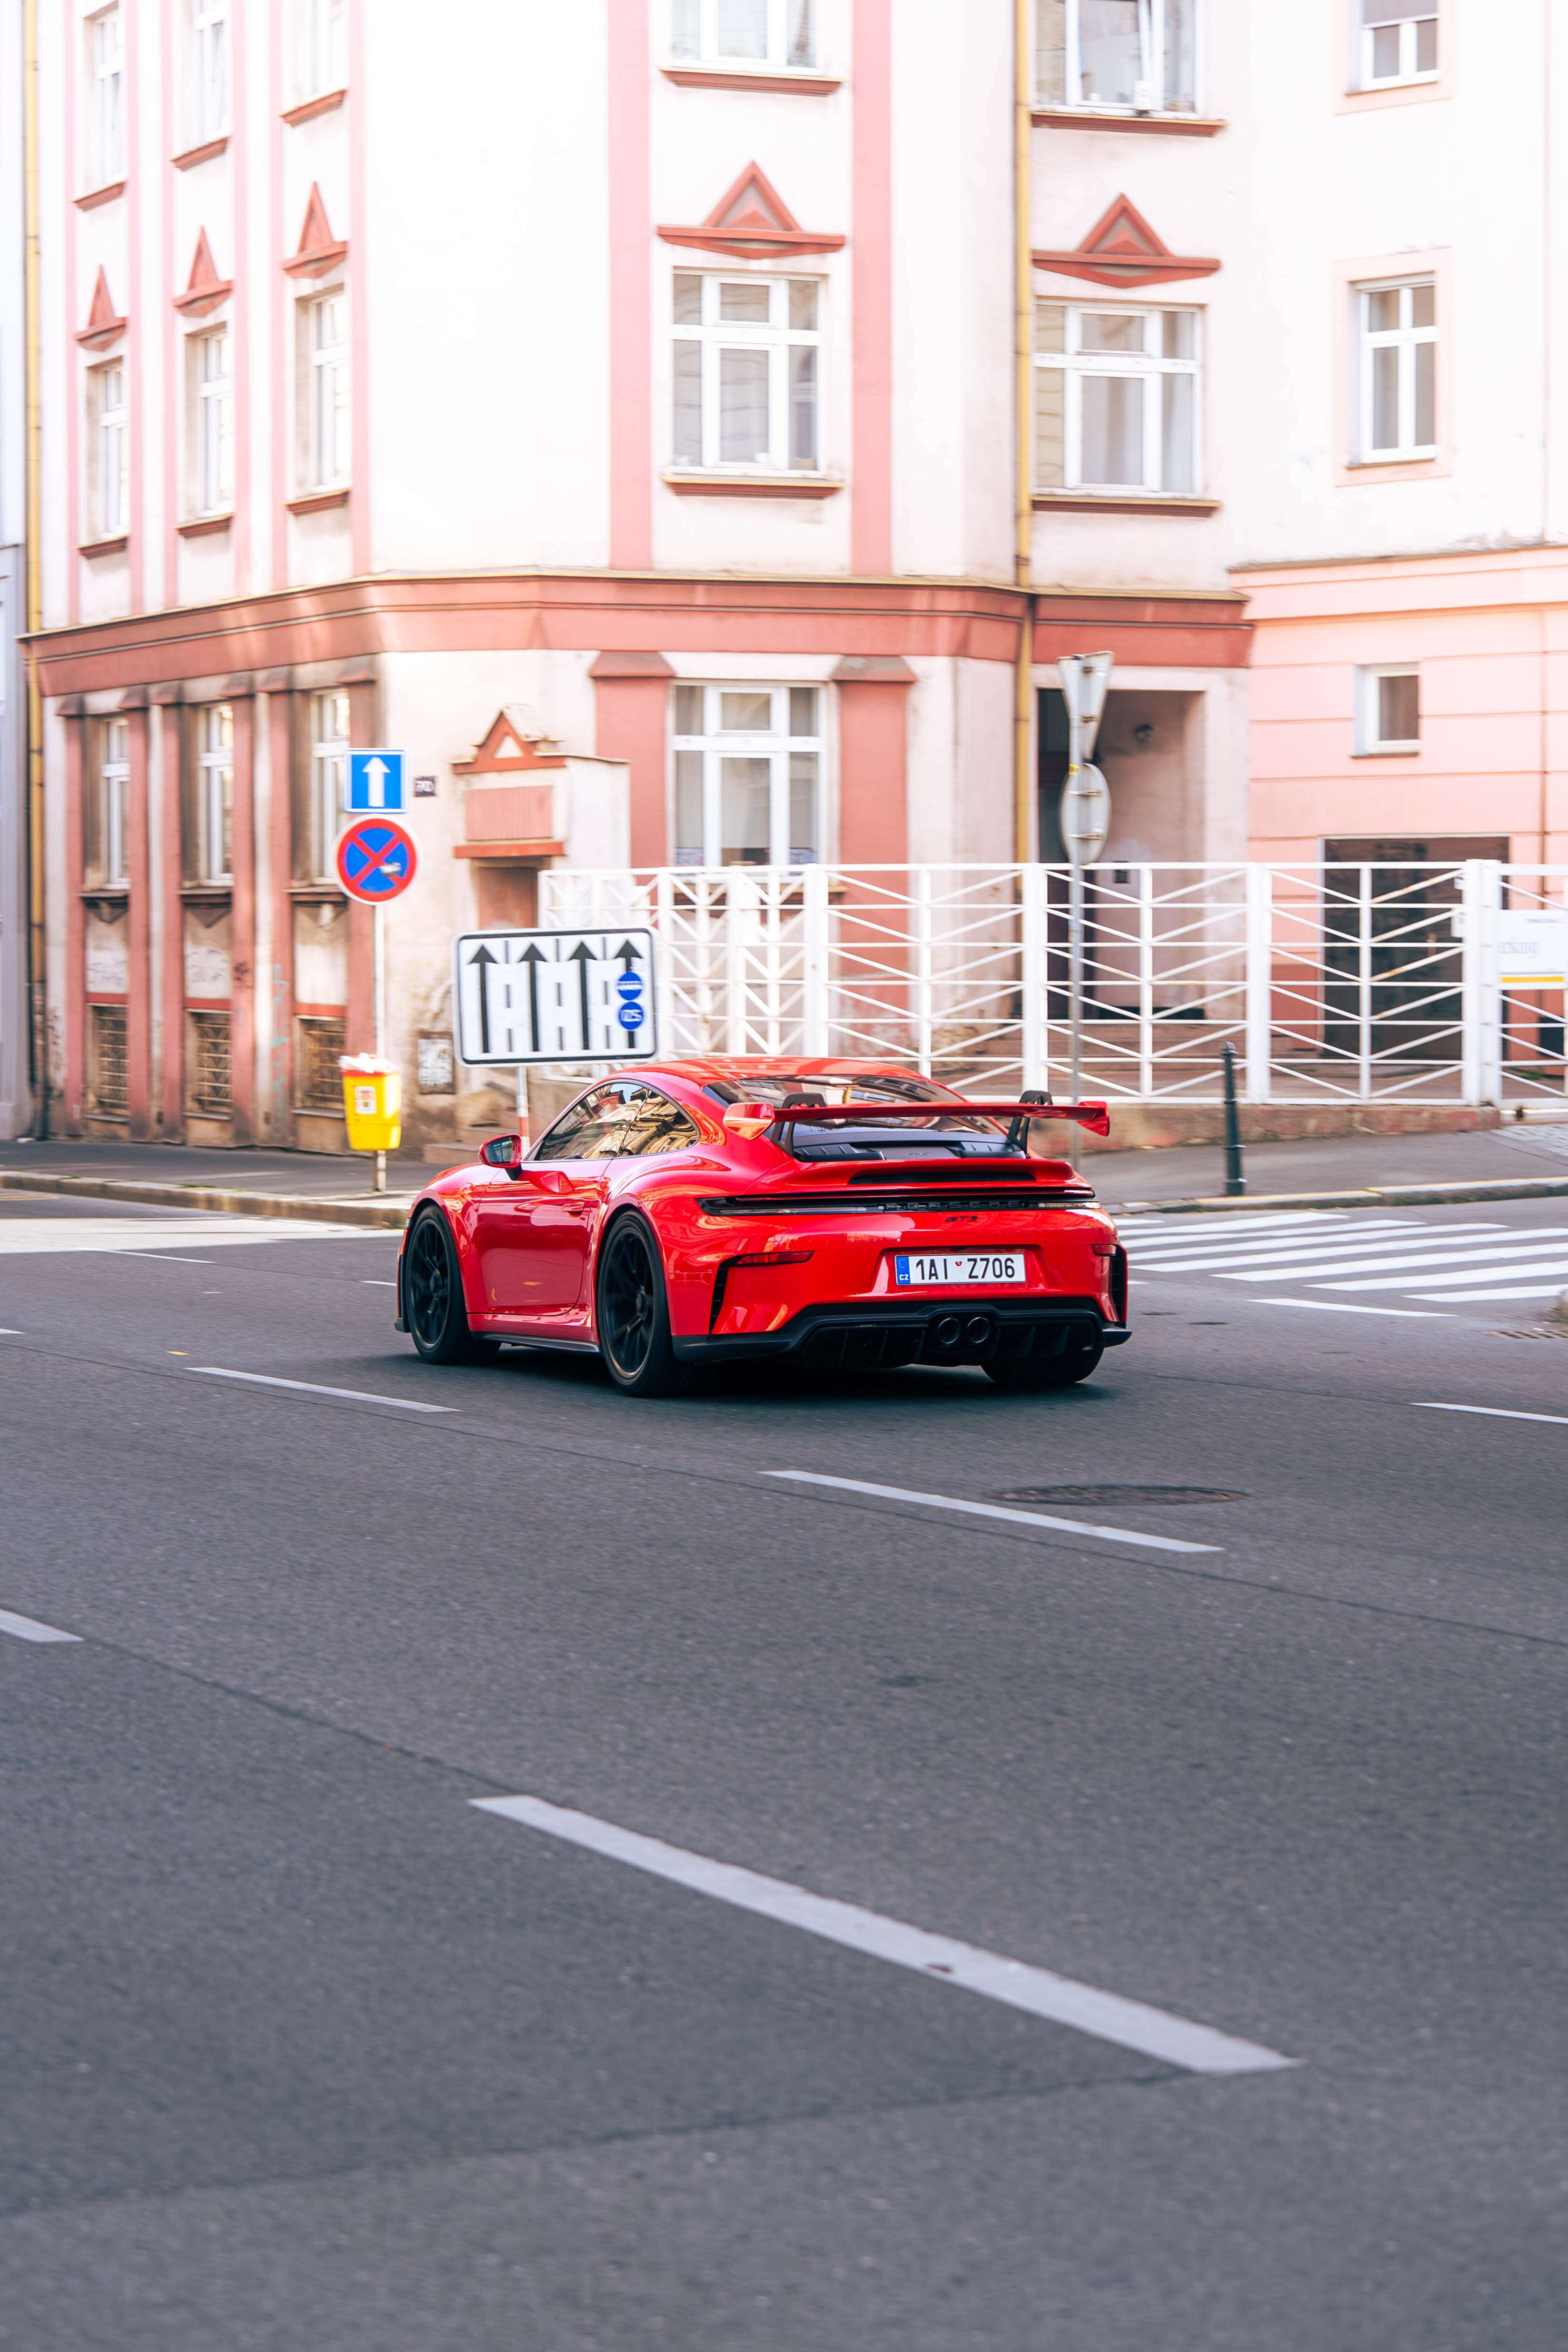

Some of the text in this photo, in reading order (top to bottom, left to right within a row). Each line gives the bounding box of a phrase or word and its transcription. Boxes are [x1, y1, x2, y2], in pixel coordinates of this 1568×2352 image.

[886, 1201, 1021, 1210] PORSCHE
[916, 1257, 1015, 1280] 1AI Z706
